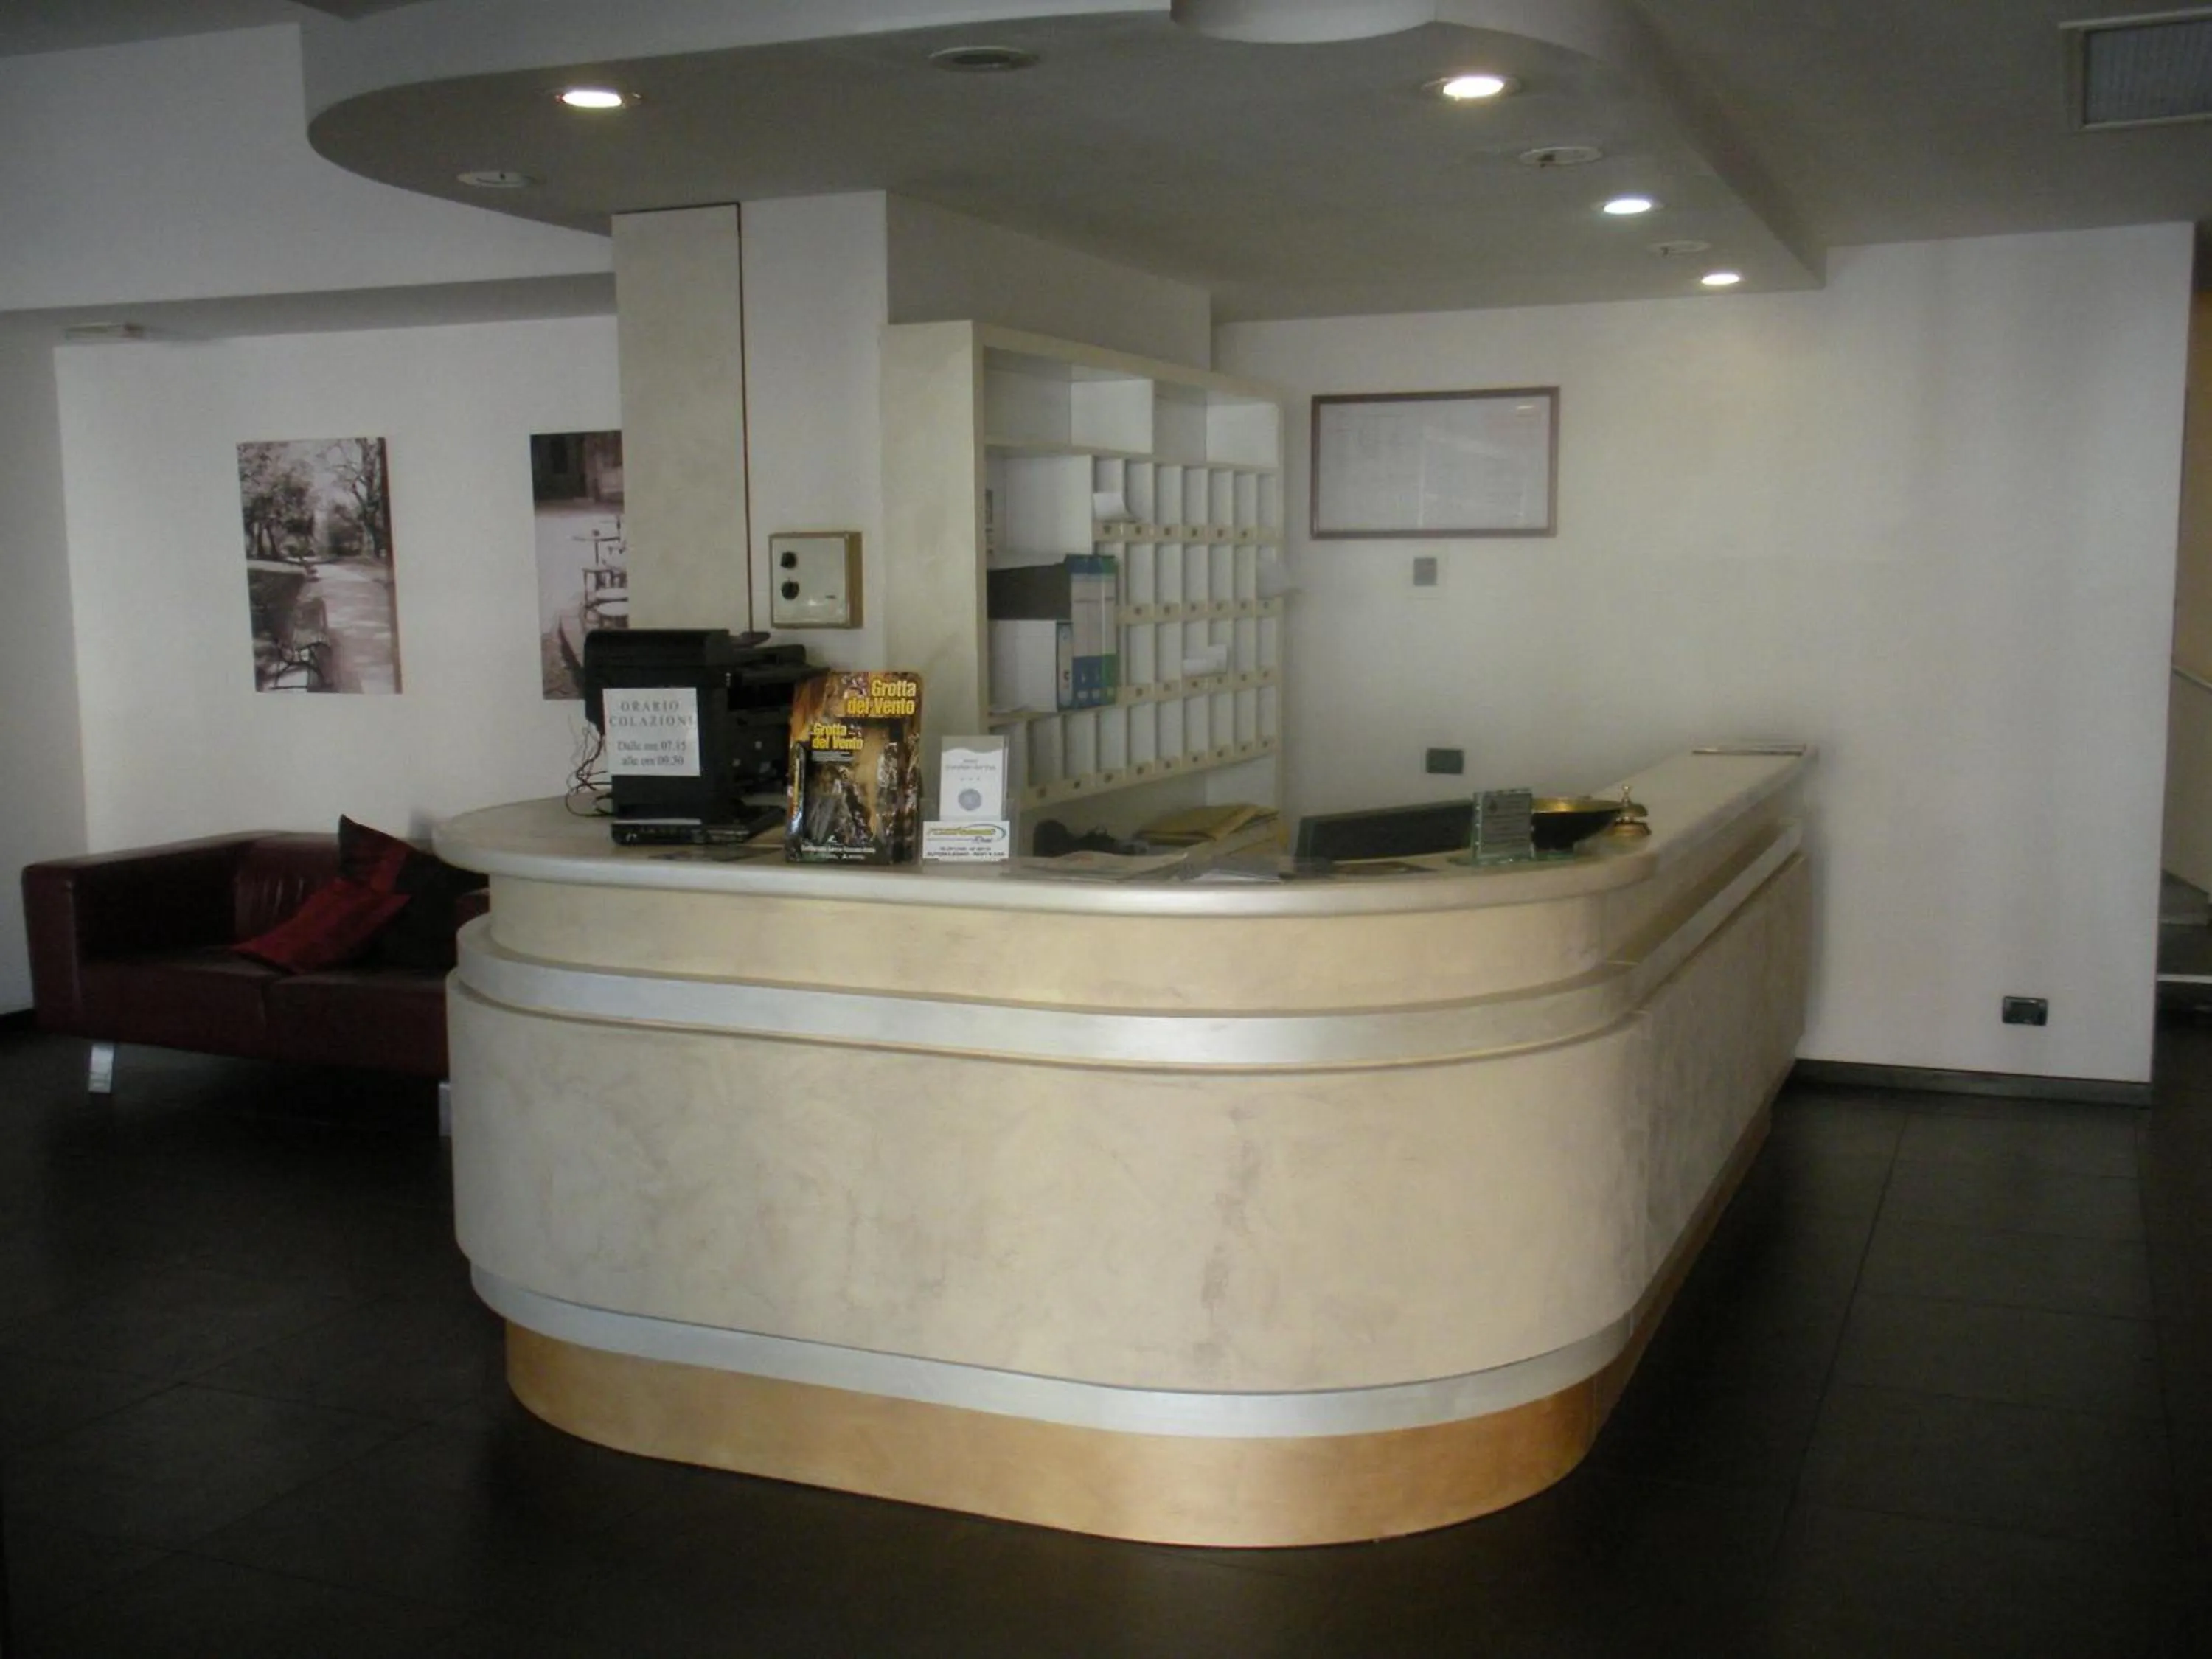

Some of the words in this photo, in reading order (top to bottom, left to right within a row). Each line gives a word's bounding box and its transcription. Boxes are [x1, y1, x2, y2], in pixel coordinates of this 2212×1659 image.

[871, 678, 917, 697] Grotta
[621, 700, 680, 712] ORARIO
[847, 697, 869, 714] del
[873, 698, 916, 715] Vento
[813, 723, 847, 736] Grotta
[812, 736, 830, 750] del
[832, 736, 864, 751] Vento
